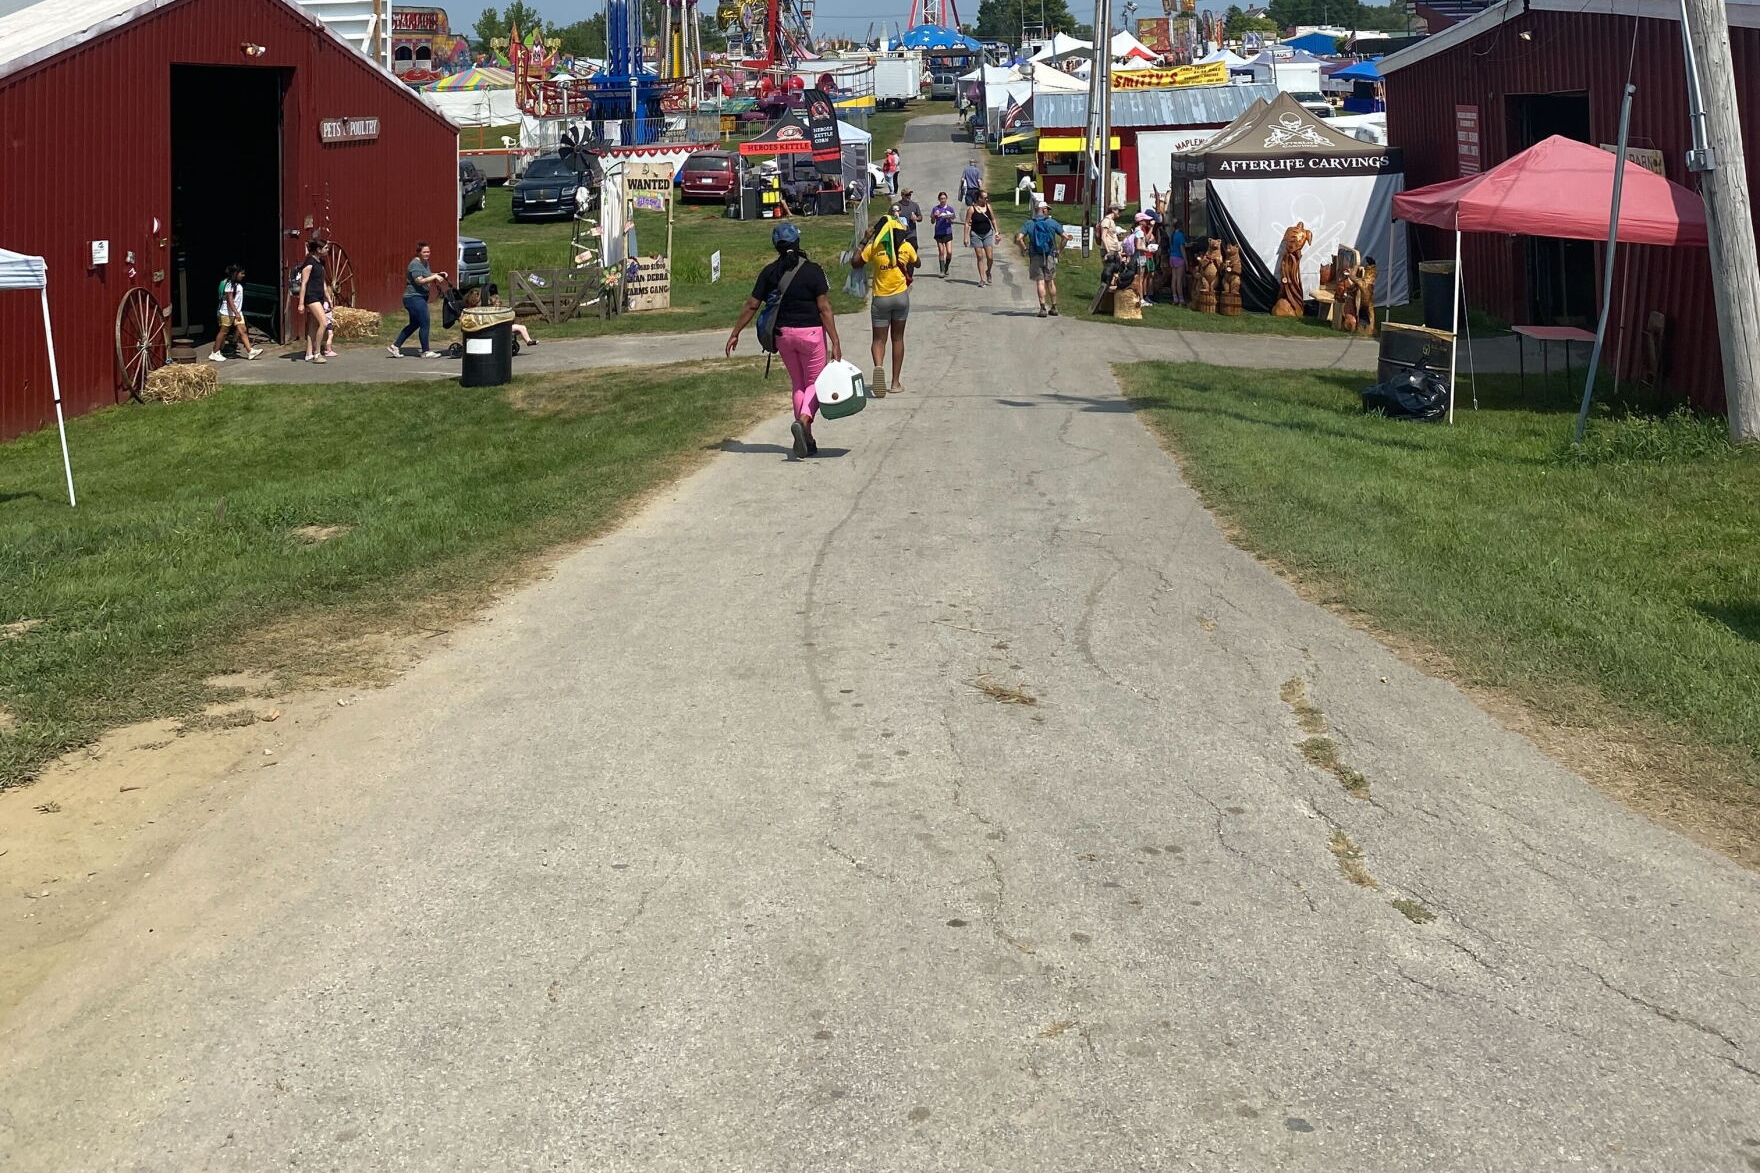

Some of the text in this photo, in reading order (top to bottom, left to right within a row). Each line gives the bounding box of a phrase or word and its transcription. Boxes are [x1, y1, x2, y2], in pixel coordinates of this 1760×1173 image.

[1113, 71, 1179, 88] SMITTY'S
[323, 122, 341, 137] PETS
[350, 120, 378, 135] POULTRY
[747, 142, 810, 152] HEROES KETTLE
[1174, 138, 1205, 151] MAPLEW
[1219, 156, 1390, 173] AFTERLIFE CARVINGS
[627, 178, 670, 190] WANTED
[647, 273, 668, 281] DEBRA
[627, 285, 669, 296] FARMS GANG
